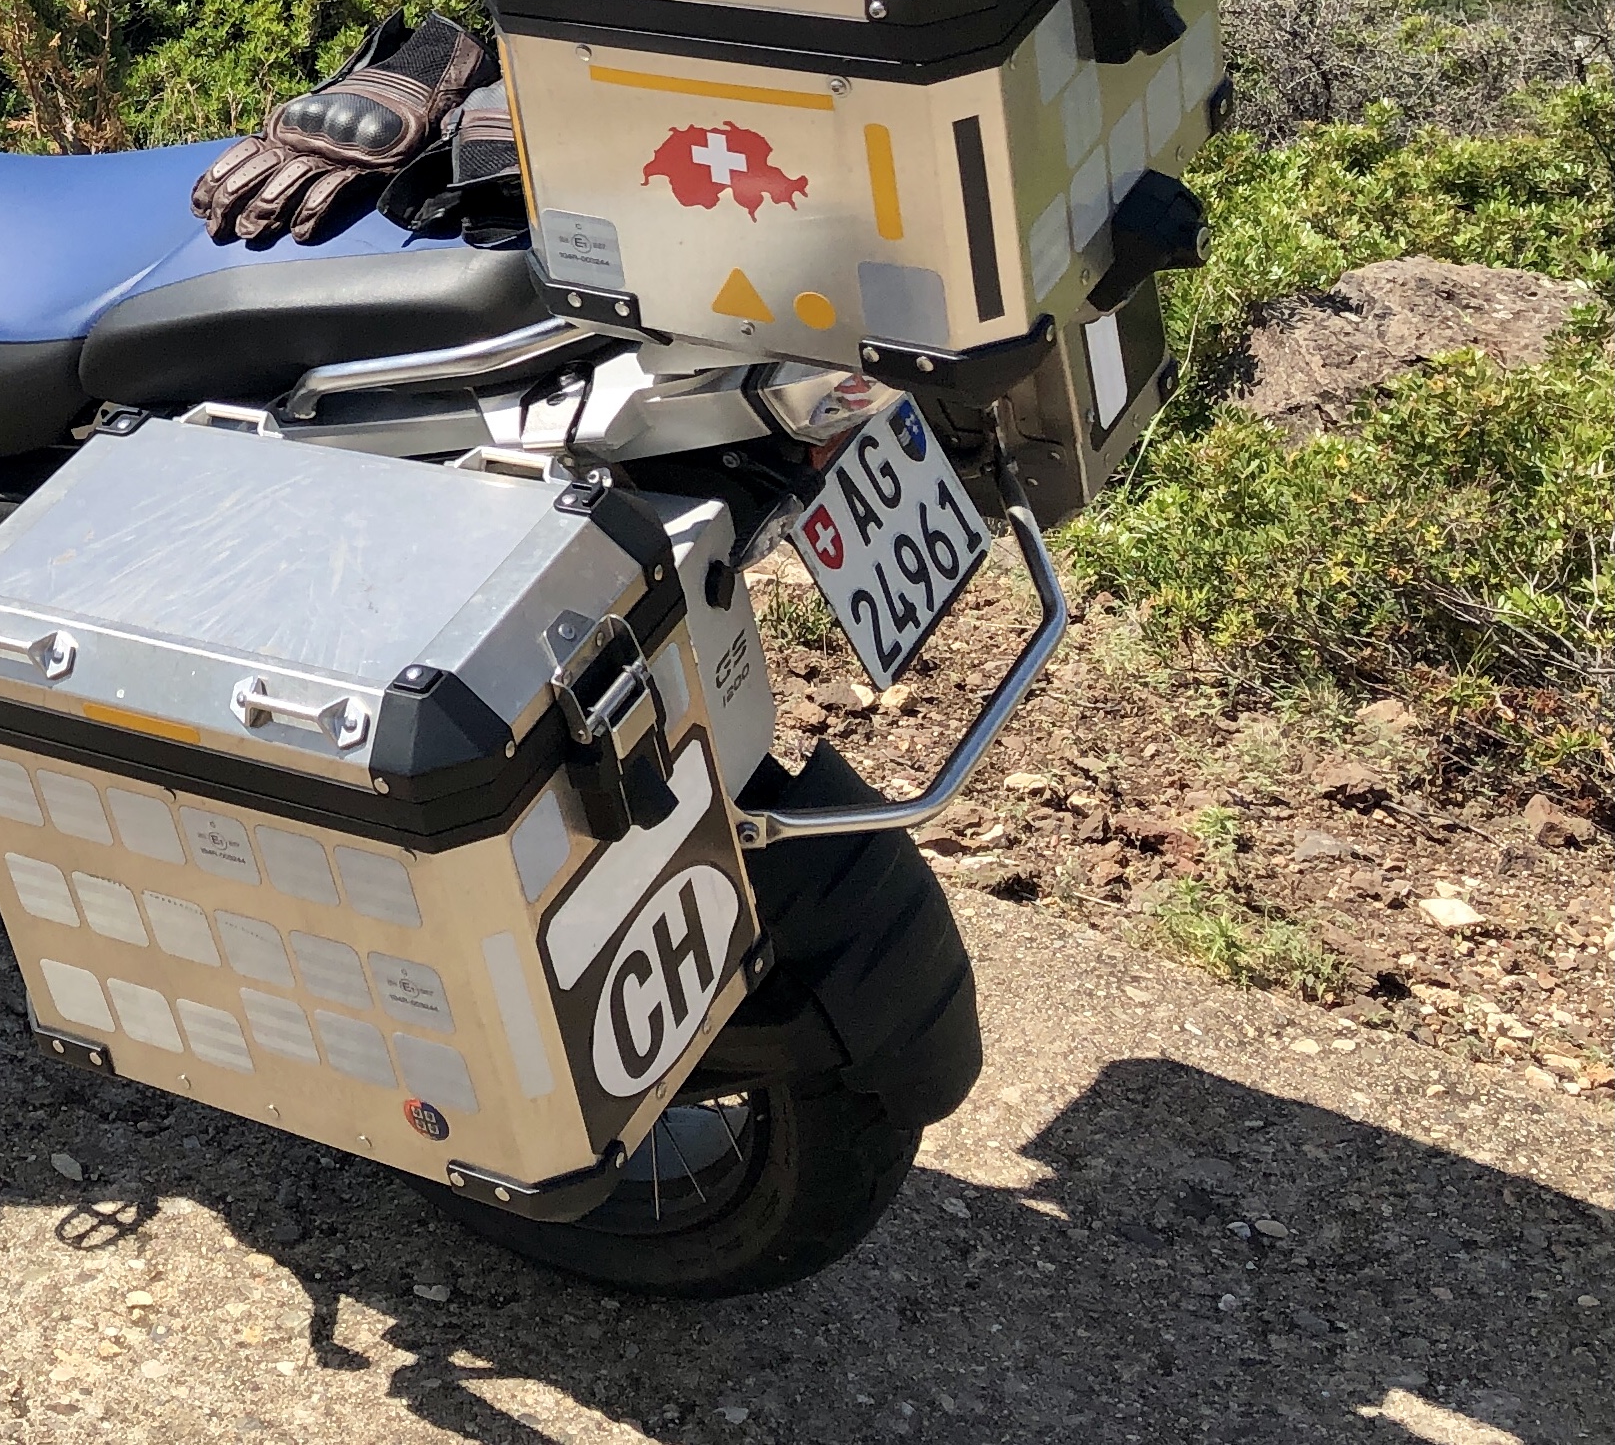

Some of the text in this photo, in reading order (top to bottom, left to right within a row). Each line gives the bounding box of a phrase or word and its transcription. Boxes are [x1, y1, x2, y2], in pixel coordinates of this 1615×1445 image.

[835, 435, 902, 547] AG
[850, 479, 983, 673] 24961
[715, 628, 747, 689] GS
[722, 662, 750, 709] 1200
[610, 878, 715, 1079] CH
